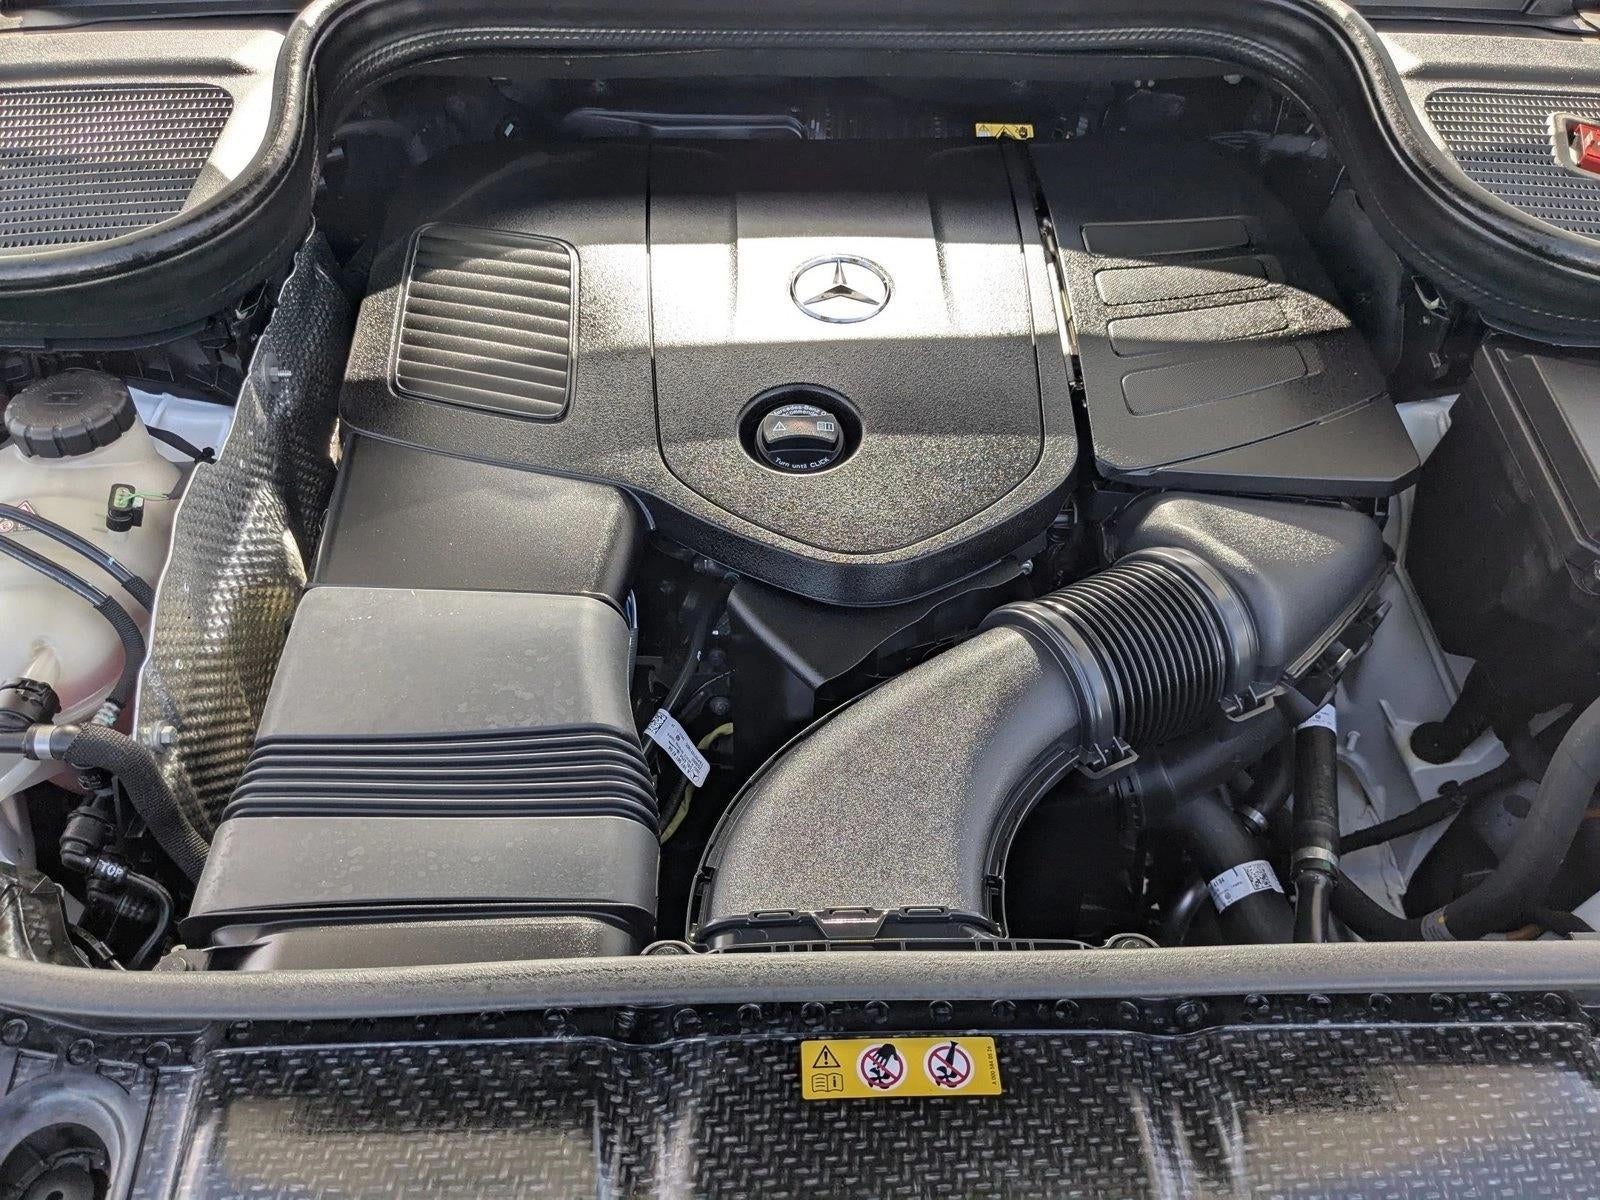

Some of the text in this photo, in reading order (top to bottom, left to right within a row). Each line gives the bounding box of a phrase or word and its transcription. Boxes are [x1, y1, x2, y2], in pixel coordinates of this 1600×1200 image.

[776, 457, 789, 467] Turn
[810, 457, 830, 468] CLICK
[99, 859, 124, 878] TOP
